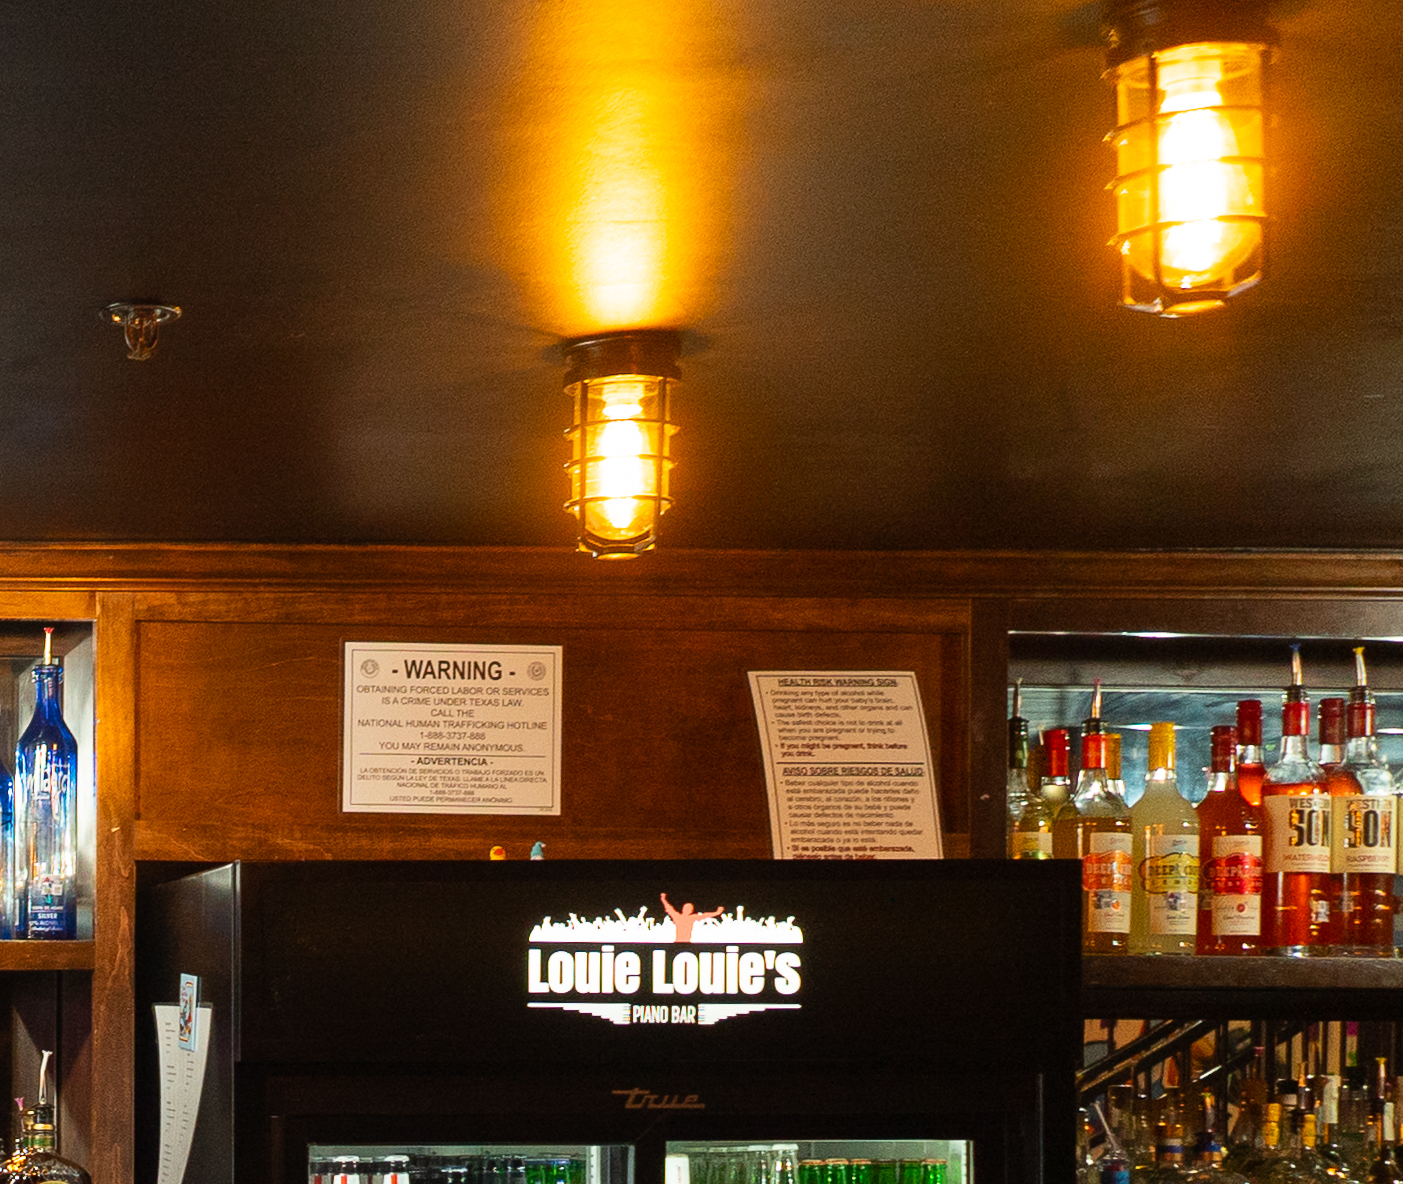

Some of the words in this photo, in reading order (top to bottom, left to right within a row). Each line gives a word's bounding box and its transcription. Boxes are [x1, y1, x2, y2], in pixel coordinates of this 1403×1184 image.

[404, 660, 502, 680] WARNING
[356, 685, 407, 693] OBTAINING
[410, 686, 449, 694] FORCED
[452, 687, 483, 695] LABOR
[486, 687, 500, 695] OR
[502, 687, 549, 696] SERVICES
[382, 697, 391, 705] IS
[393, 697, 399, 705] A
[401, 697, 431, 705] CRIME
[434, 698, 466, 706] UNDER
[470, 698, 500, 707] TEXAS
[431, 709, 453, 717] CALL
[457, 709, 474, 717] THE
[358, 719, 403, 727] NATIONAL
[406, 720, 439, 728] HUMAN
[443, 720, 504, 729] TRAFFICKING
[507, 721, 547, 730] HOTLINE
[379, 742, 399, 750] YOU
[402, 742, 421, 750] MAY
[424, 743, 460, 751] REMAIN
[416, 757, 488, 766] ADVERTENCIA
[1343, 809, 1393, 848] SON
[38, 912, 58, 920] SILVER
[528, 945, 641, 994] Louie
[653, 945, 802, 995] Louie's
[633, 1005, 669, 1024] PIANO
[672, 1005, 696, 1024] BAR
